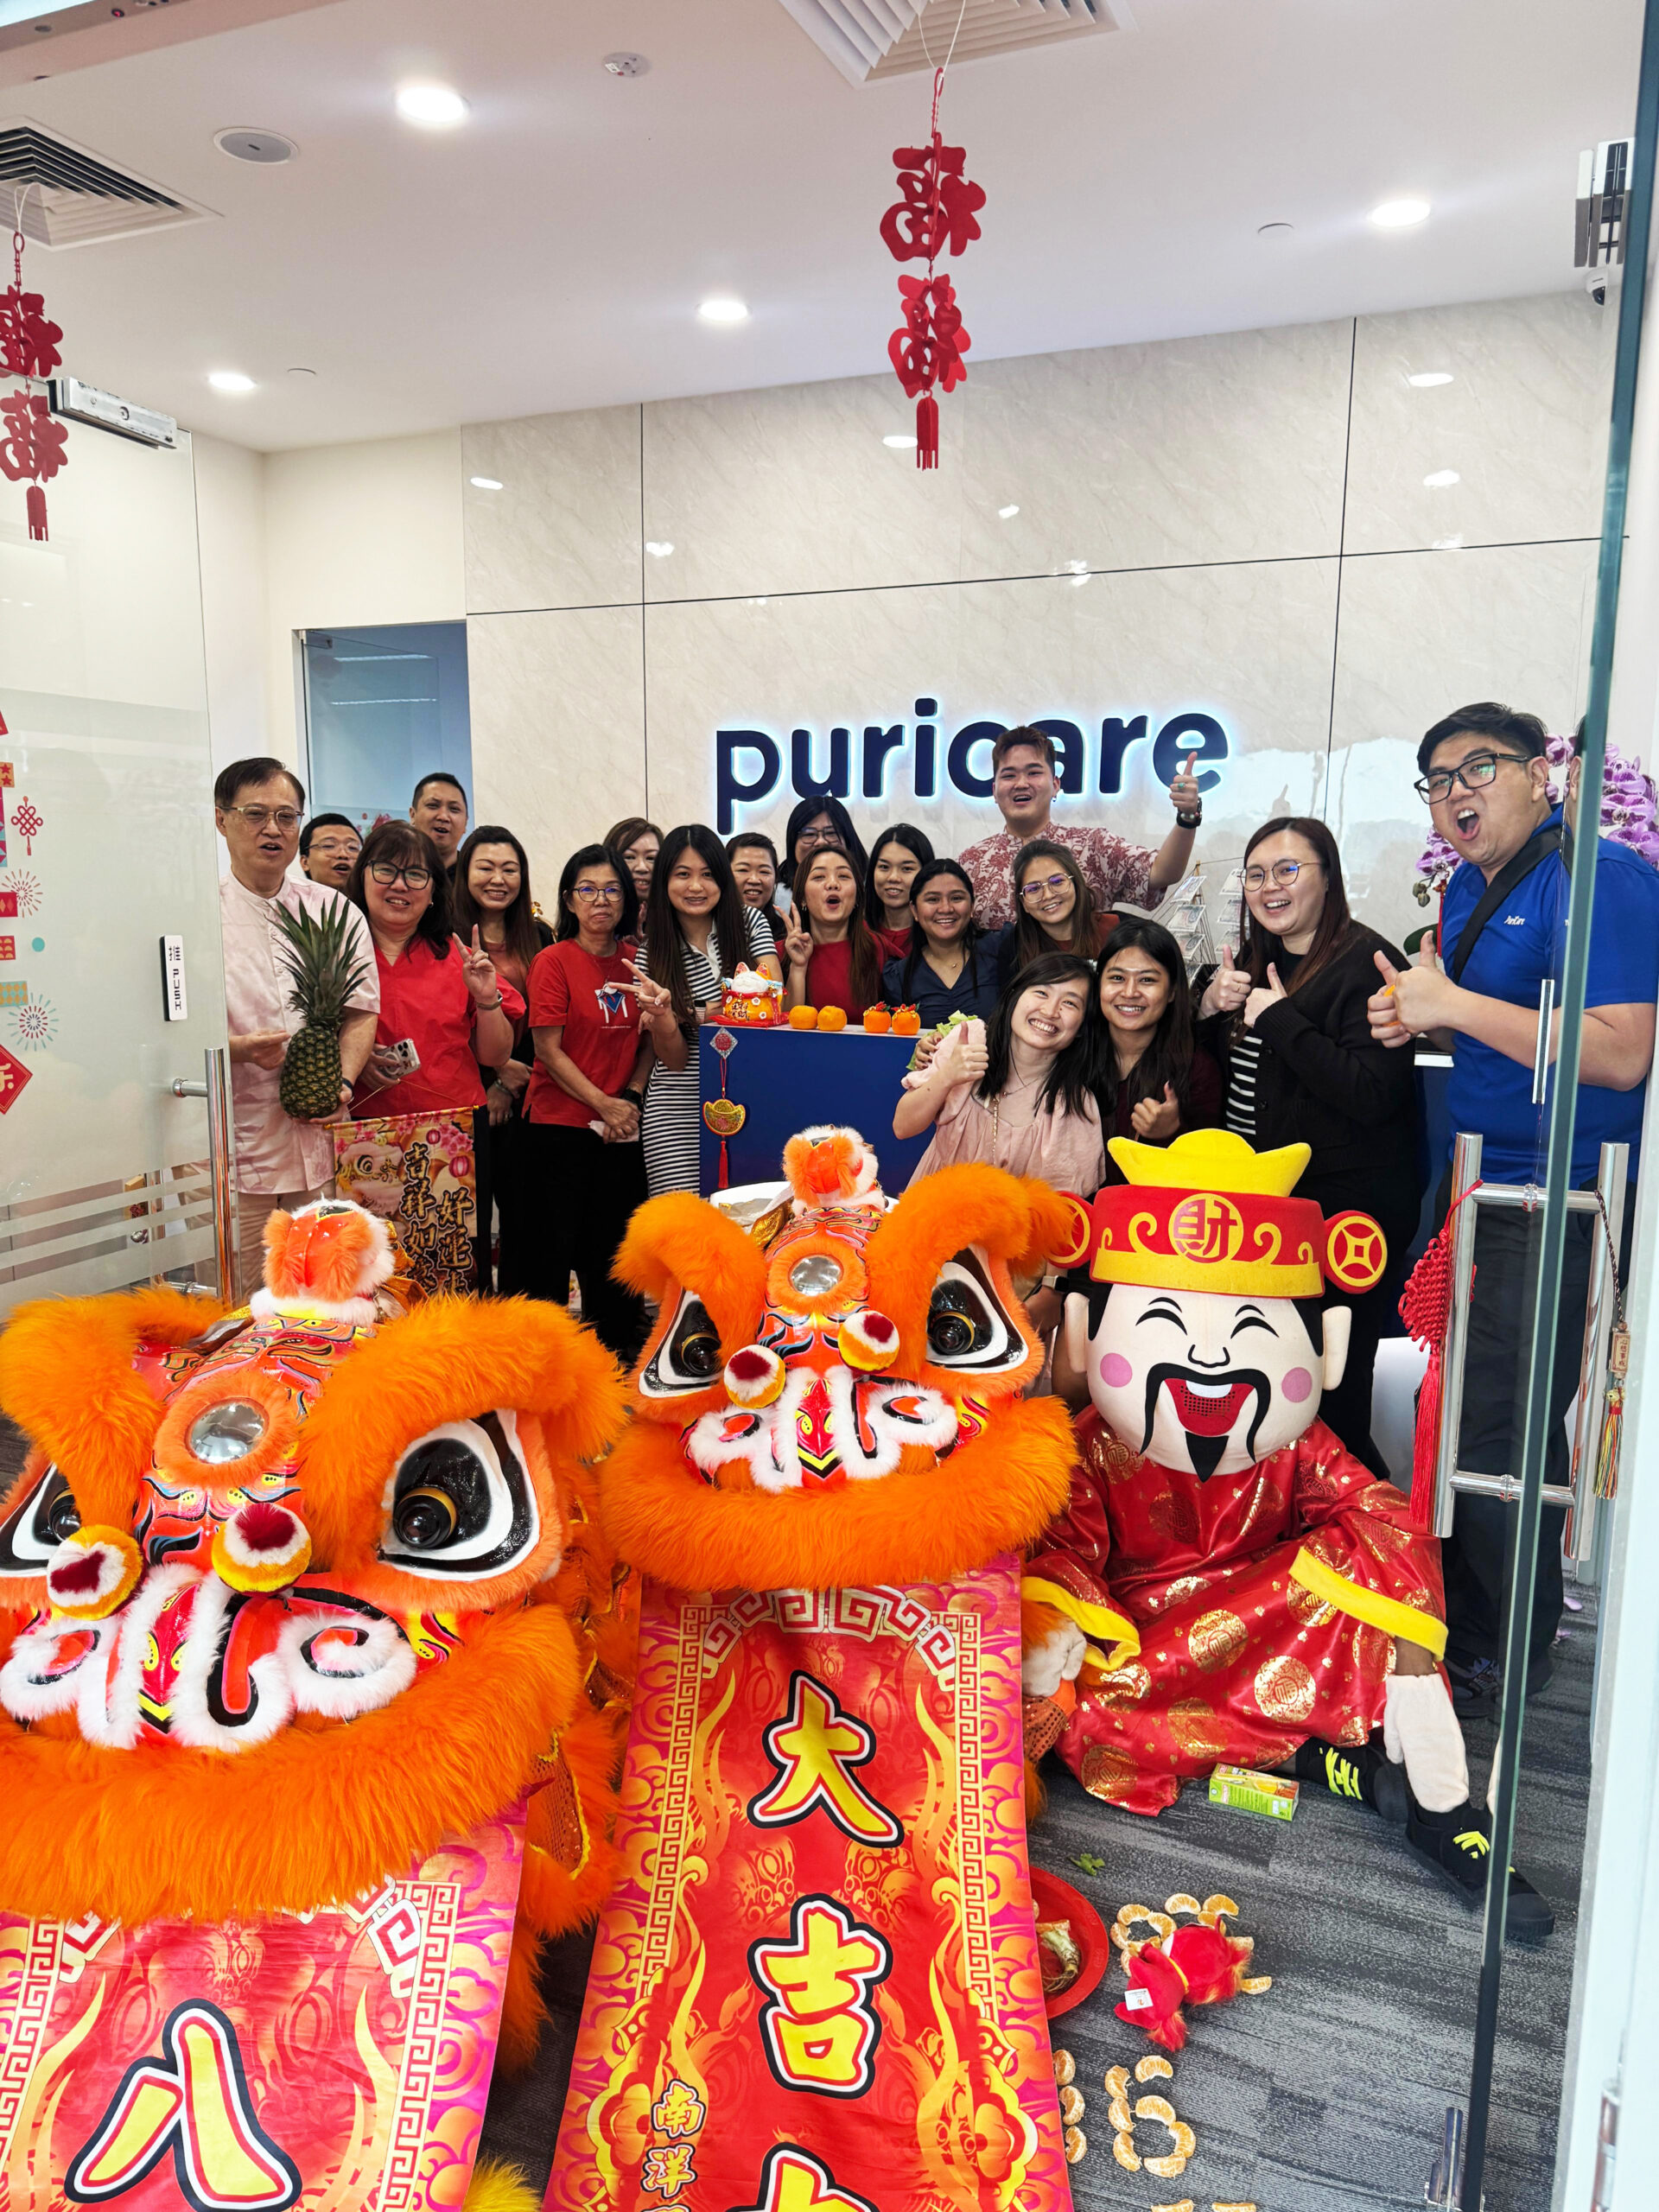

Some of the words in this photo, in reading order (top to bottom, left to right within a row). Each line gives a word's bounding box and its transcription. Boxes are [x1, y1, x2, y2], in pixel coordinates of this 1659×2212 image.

[716, 698, 1229, 835] puricare
[173, 968, 181, 1010] PUSH
[1169, 1194, 1239, 1263] 財
[64, 1998, 303, 2212] 八
[639, 2079, 705, 2212] 南洋
